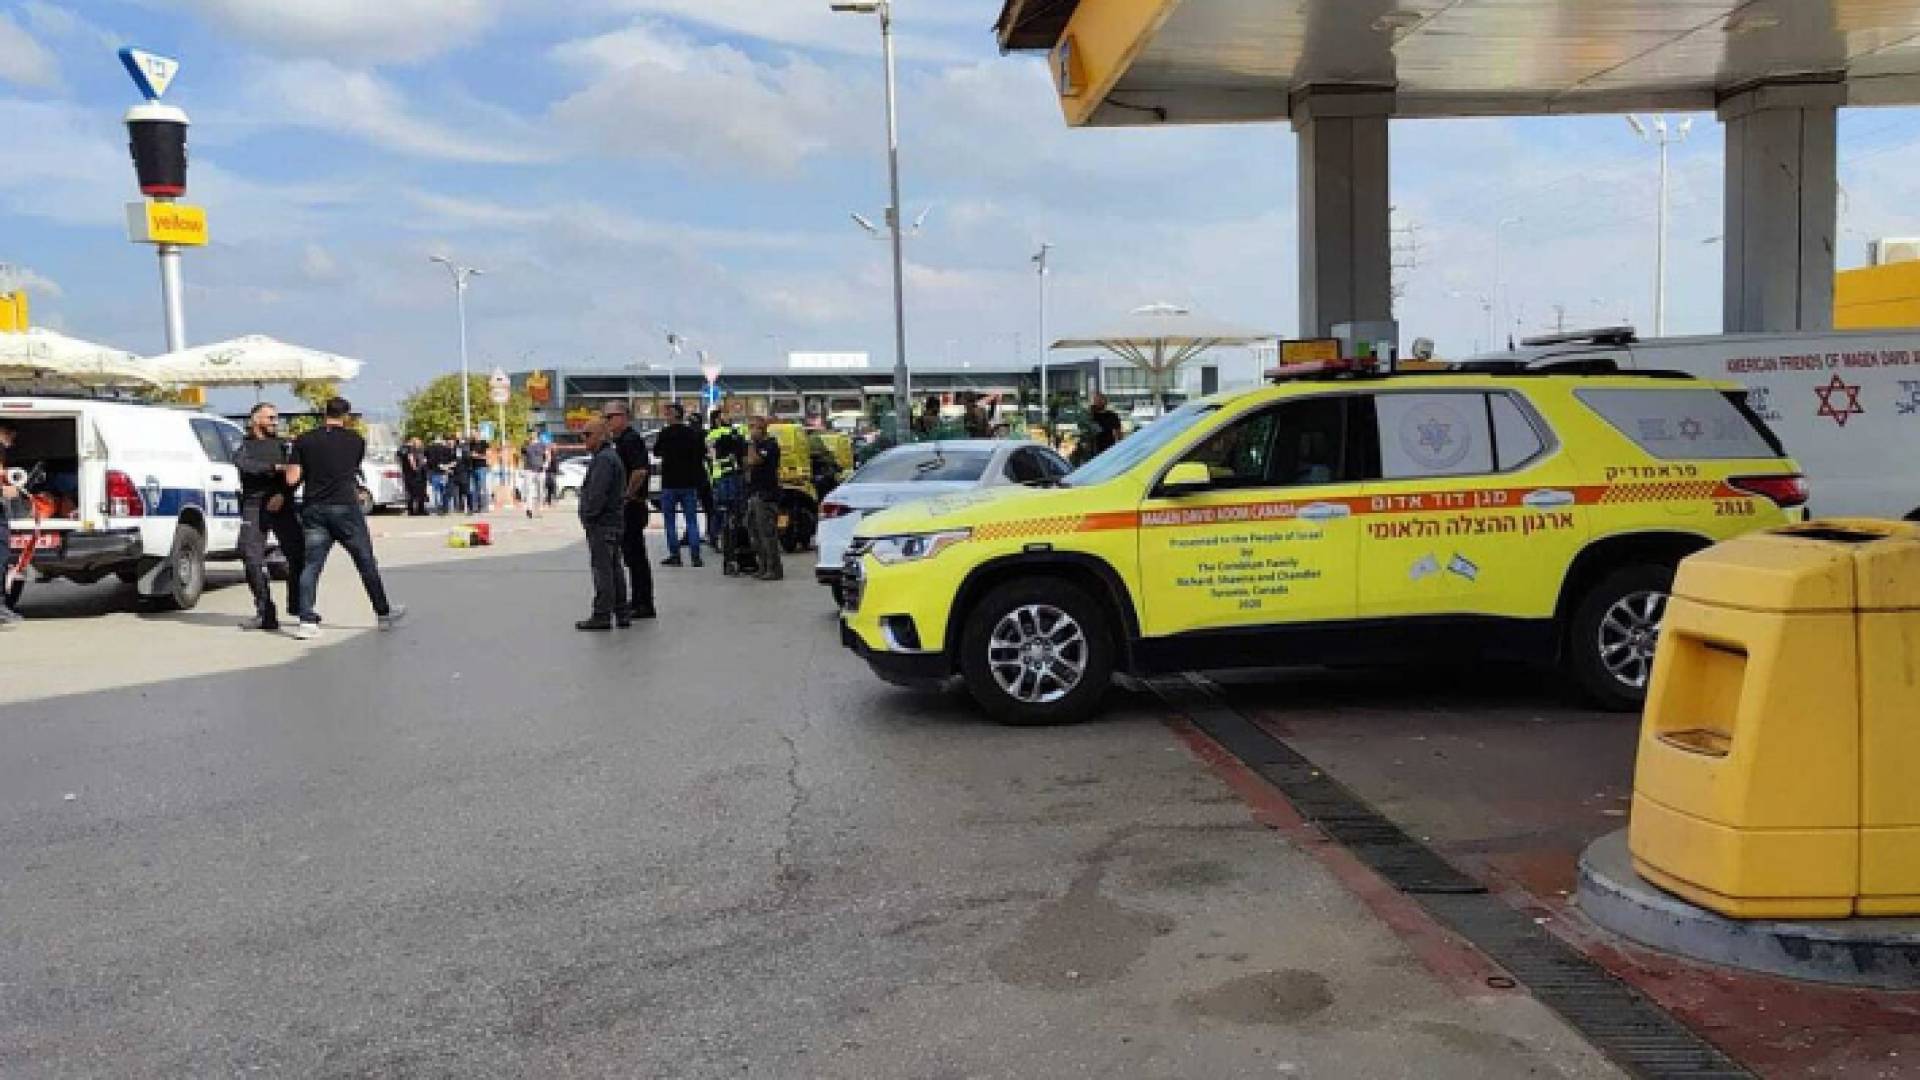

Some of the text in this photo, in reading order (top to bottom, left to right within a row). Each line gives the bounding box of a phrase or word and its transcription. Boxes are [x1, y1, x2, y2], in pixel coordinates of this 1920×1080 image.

[153, 215, 203, 233] yellow
[1779, 354, 1823, 370] FRIENDS
[1825, 353, 1840, 367] OF
[1841, 351, 1878, 368] MAGEN
[1880, 350, 1910, 365] DAVID
[1604, 465, 1697, 481] פראמדיק
[1370, 490, 1508, 511] מגן דוד אדום
[1368, 512, 1573, 539] ארגון ההצלה הלאומי
